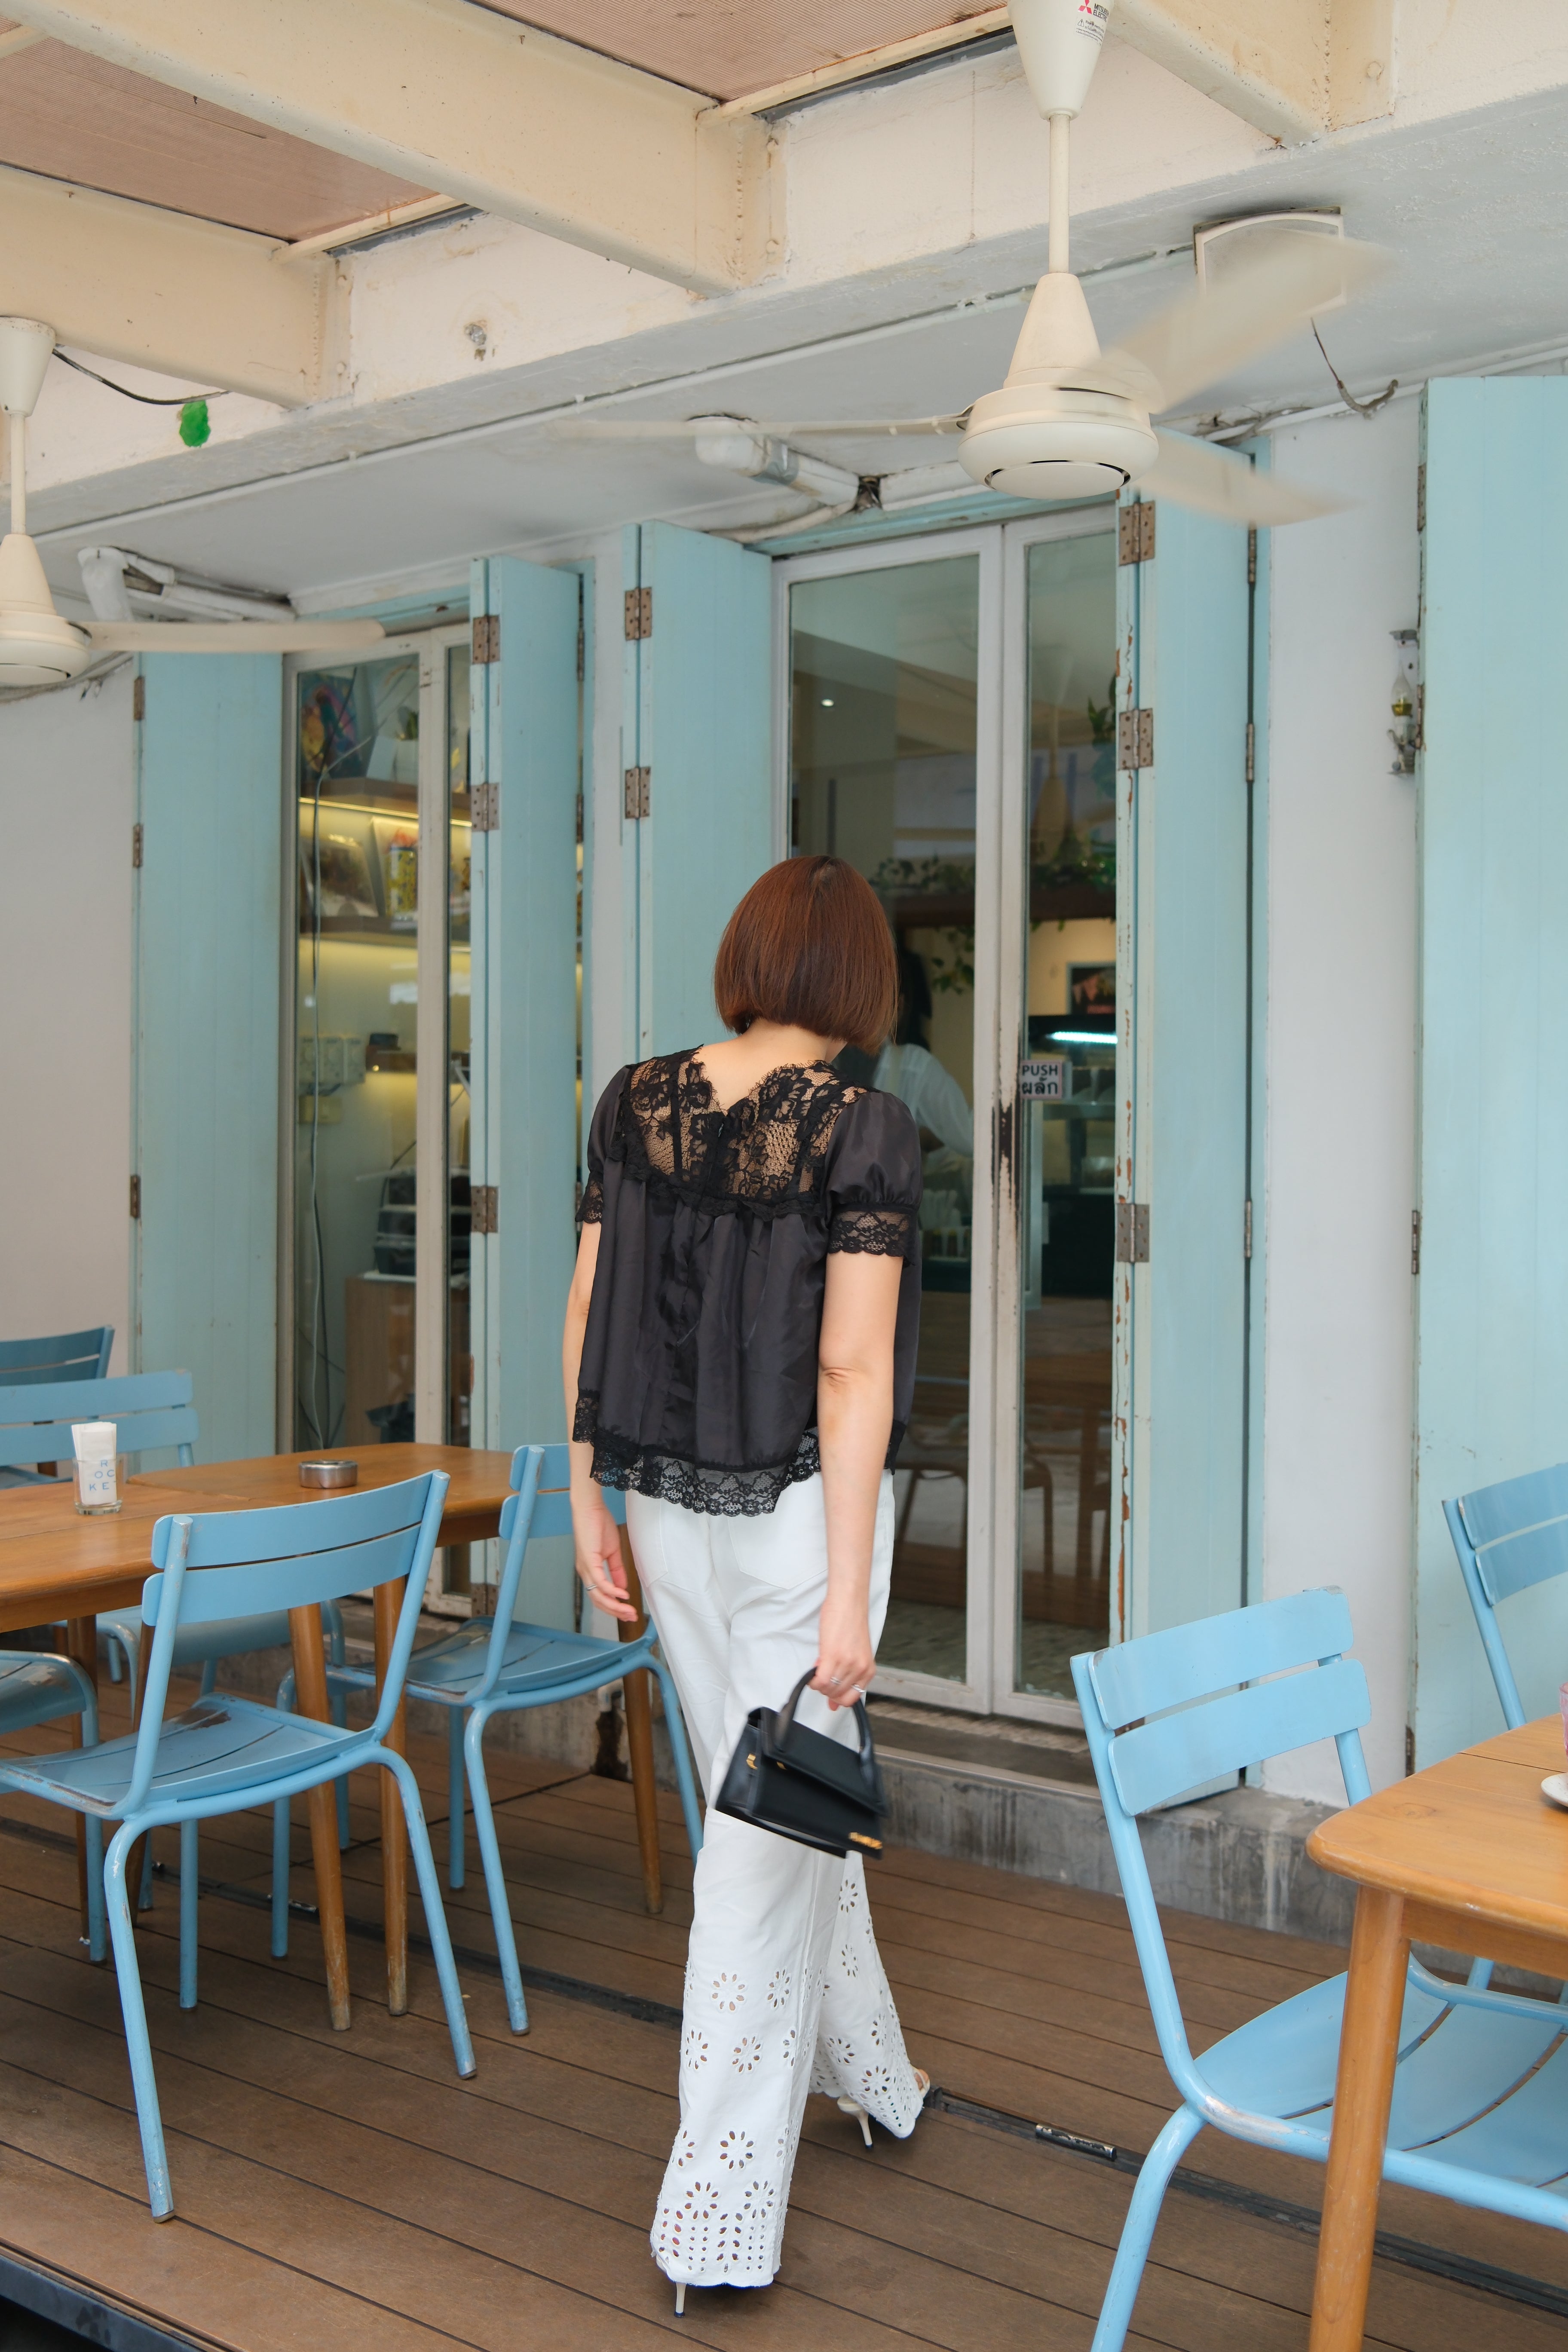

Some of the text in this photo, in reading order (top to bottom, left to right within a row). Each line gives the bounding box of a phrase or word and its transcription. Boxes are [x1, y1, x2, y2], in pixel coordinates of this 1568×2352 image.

[1022, 1064, 1058, 1076] PUSH
[1022, 1077, 1058, 1094] ผลัก
[95, 1469, 115, 1479] OC
